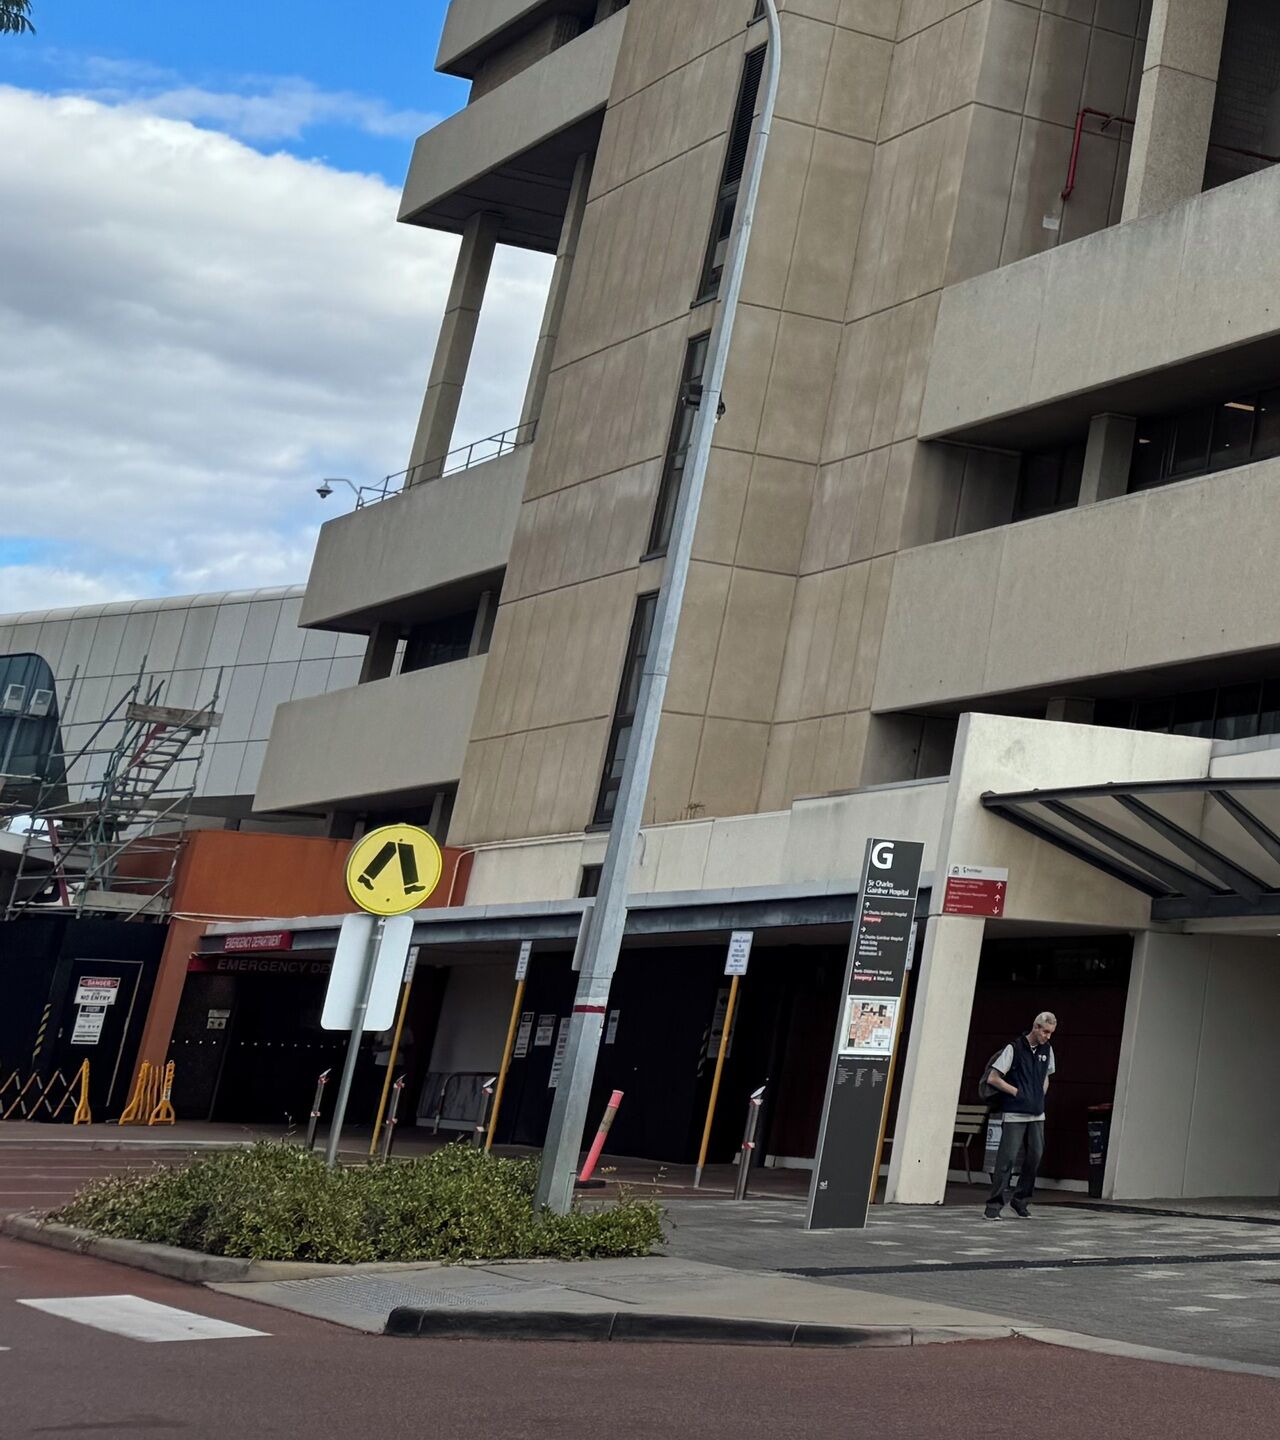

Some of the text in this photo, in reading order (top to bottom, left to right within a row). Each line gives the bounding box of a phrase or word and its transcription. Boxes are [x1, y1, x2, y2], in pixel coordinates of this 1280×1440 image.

[872, 842, 894, 869] G
[876, 880, 893, 888] Charles
[889, 889, 909, 897] Hospital
[217, 960, 306, 973] EMERGENCY
